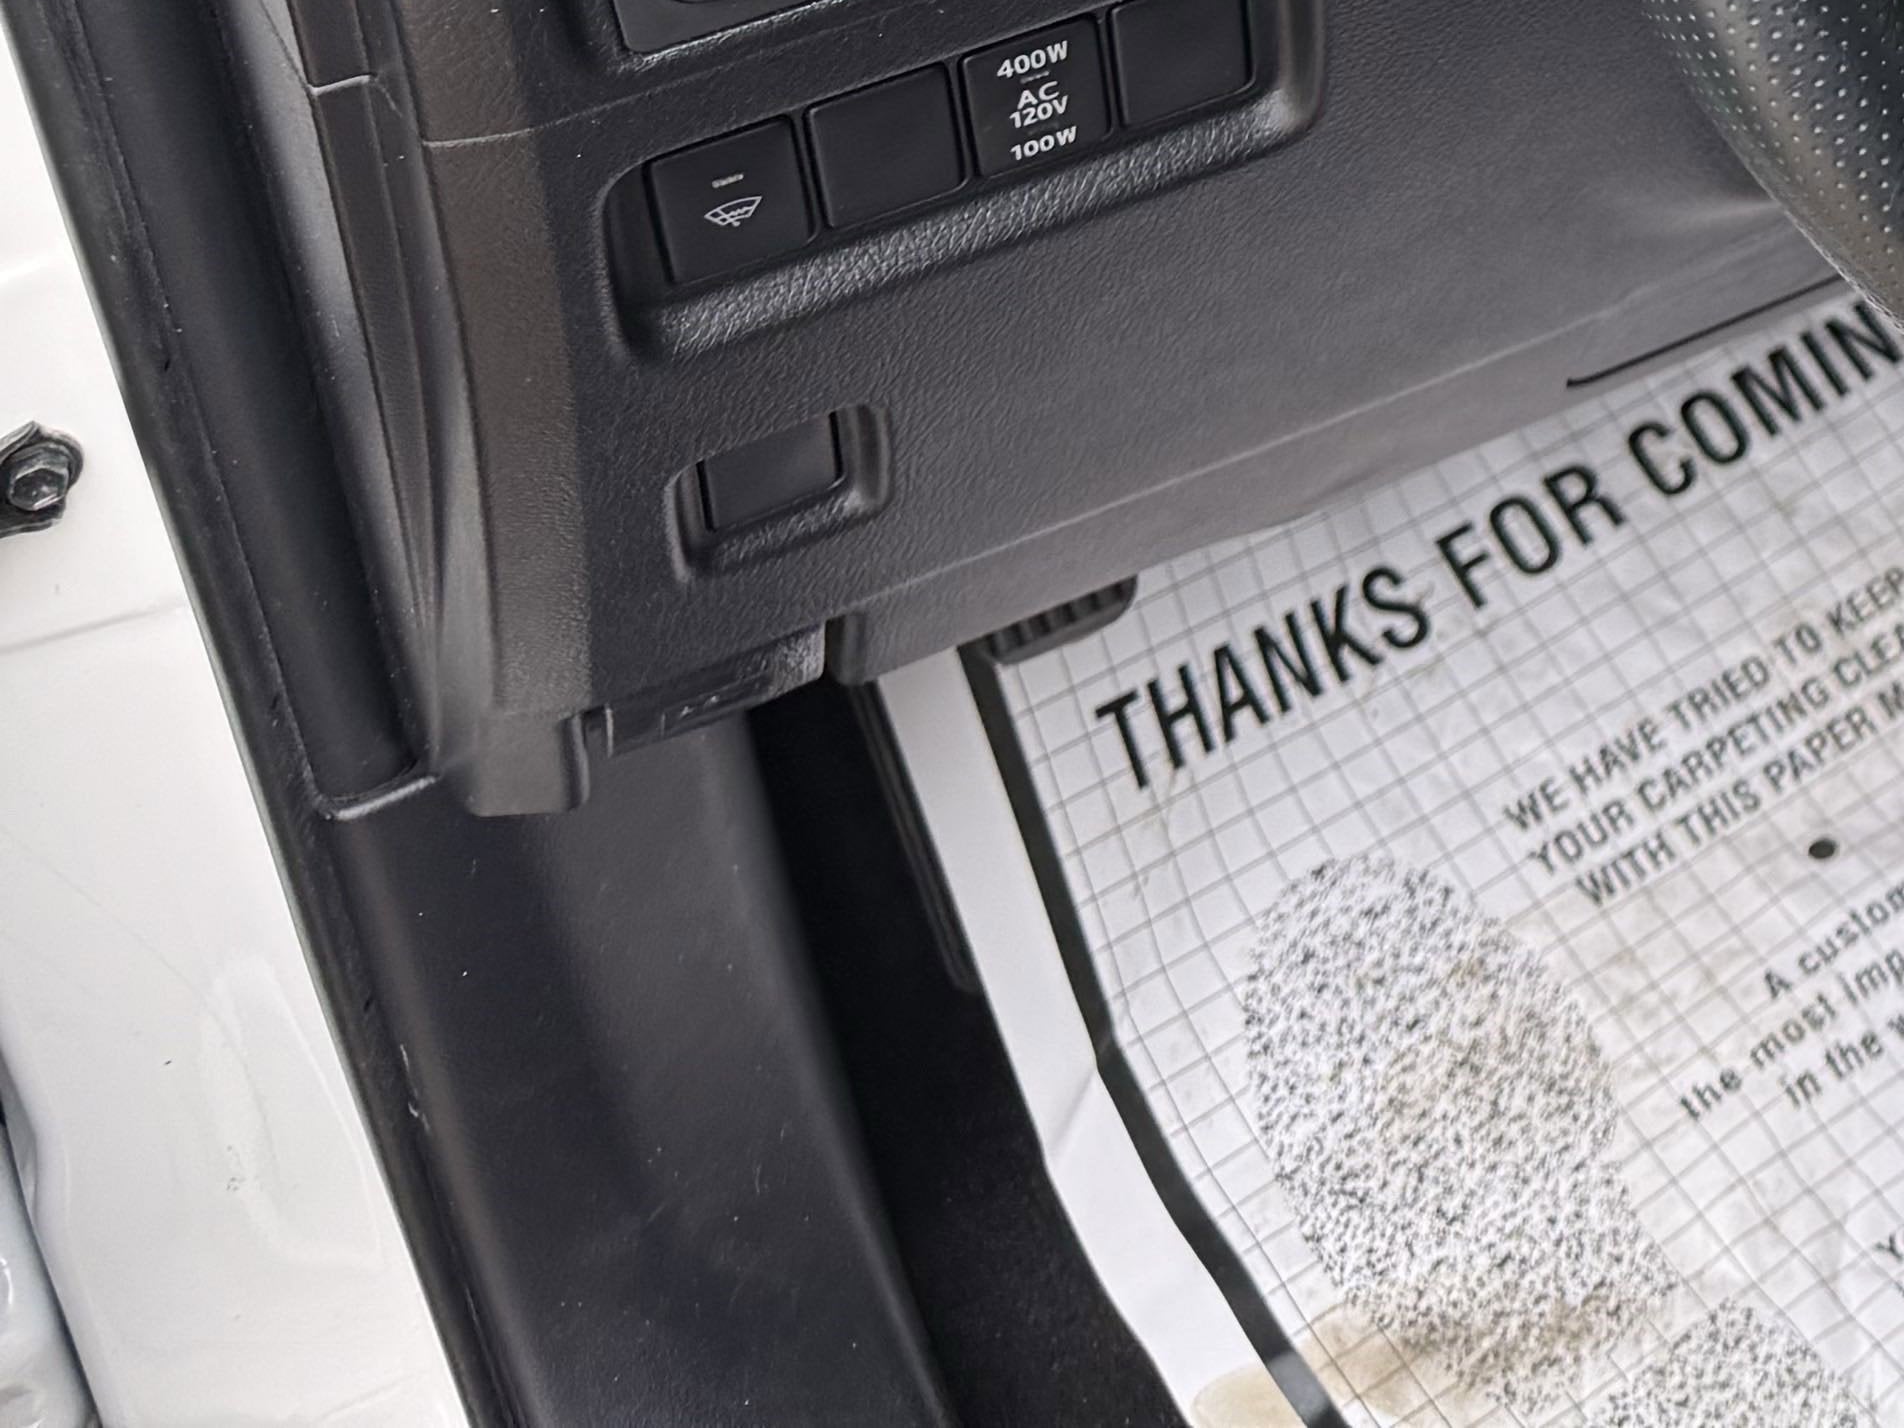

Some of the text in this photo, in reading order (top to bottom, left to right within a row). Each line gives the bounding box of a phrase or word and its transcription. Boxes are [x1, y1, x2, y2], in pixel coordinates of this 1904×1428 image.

[996, 40, 1068, 78] 400W
[1017, 80, 1060, 110] AC
[1009, 95, 1068, 128] 120V
[1010, 125, 1077, 161] 100W
[1095, 300, 1904, 790] THANKS FOR COMIN
[1503, 776, 1572, 834] WE
[1568, 717, 1669, 797] HAVE
[1667, 655, 1771, 732] TRIED
[1773, 621, 1822, 667] TO
[1529, 797, 1636, 878] YOUR
[1635, 676, 1830, 814] CARPETING
[1575, 830, 1678, 908] WITH
[1674, 781, 1762, 847] THIS
[1761, 705, 1879, 796] PAPER
[1762, 967, 1794, 1001] A
[1679, 1066, 1742, 1123] the
[1750, 991, 1837, 1071] most
[1784, 1075, 1822, 1110] in
[1825, 1028, 1887, 1083] the
